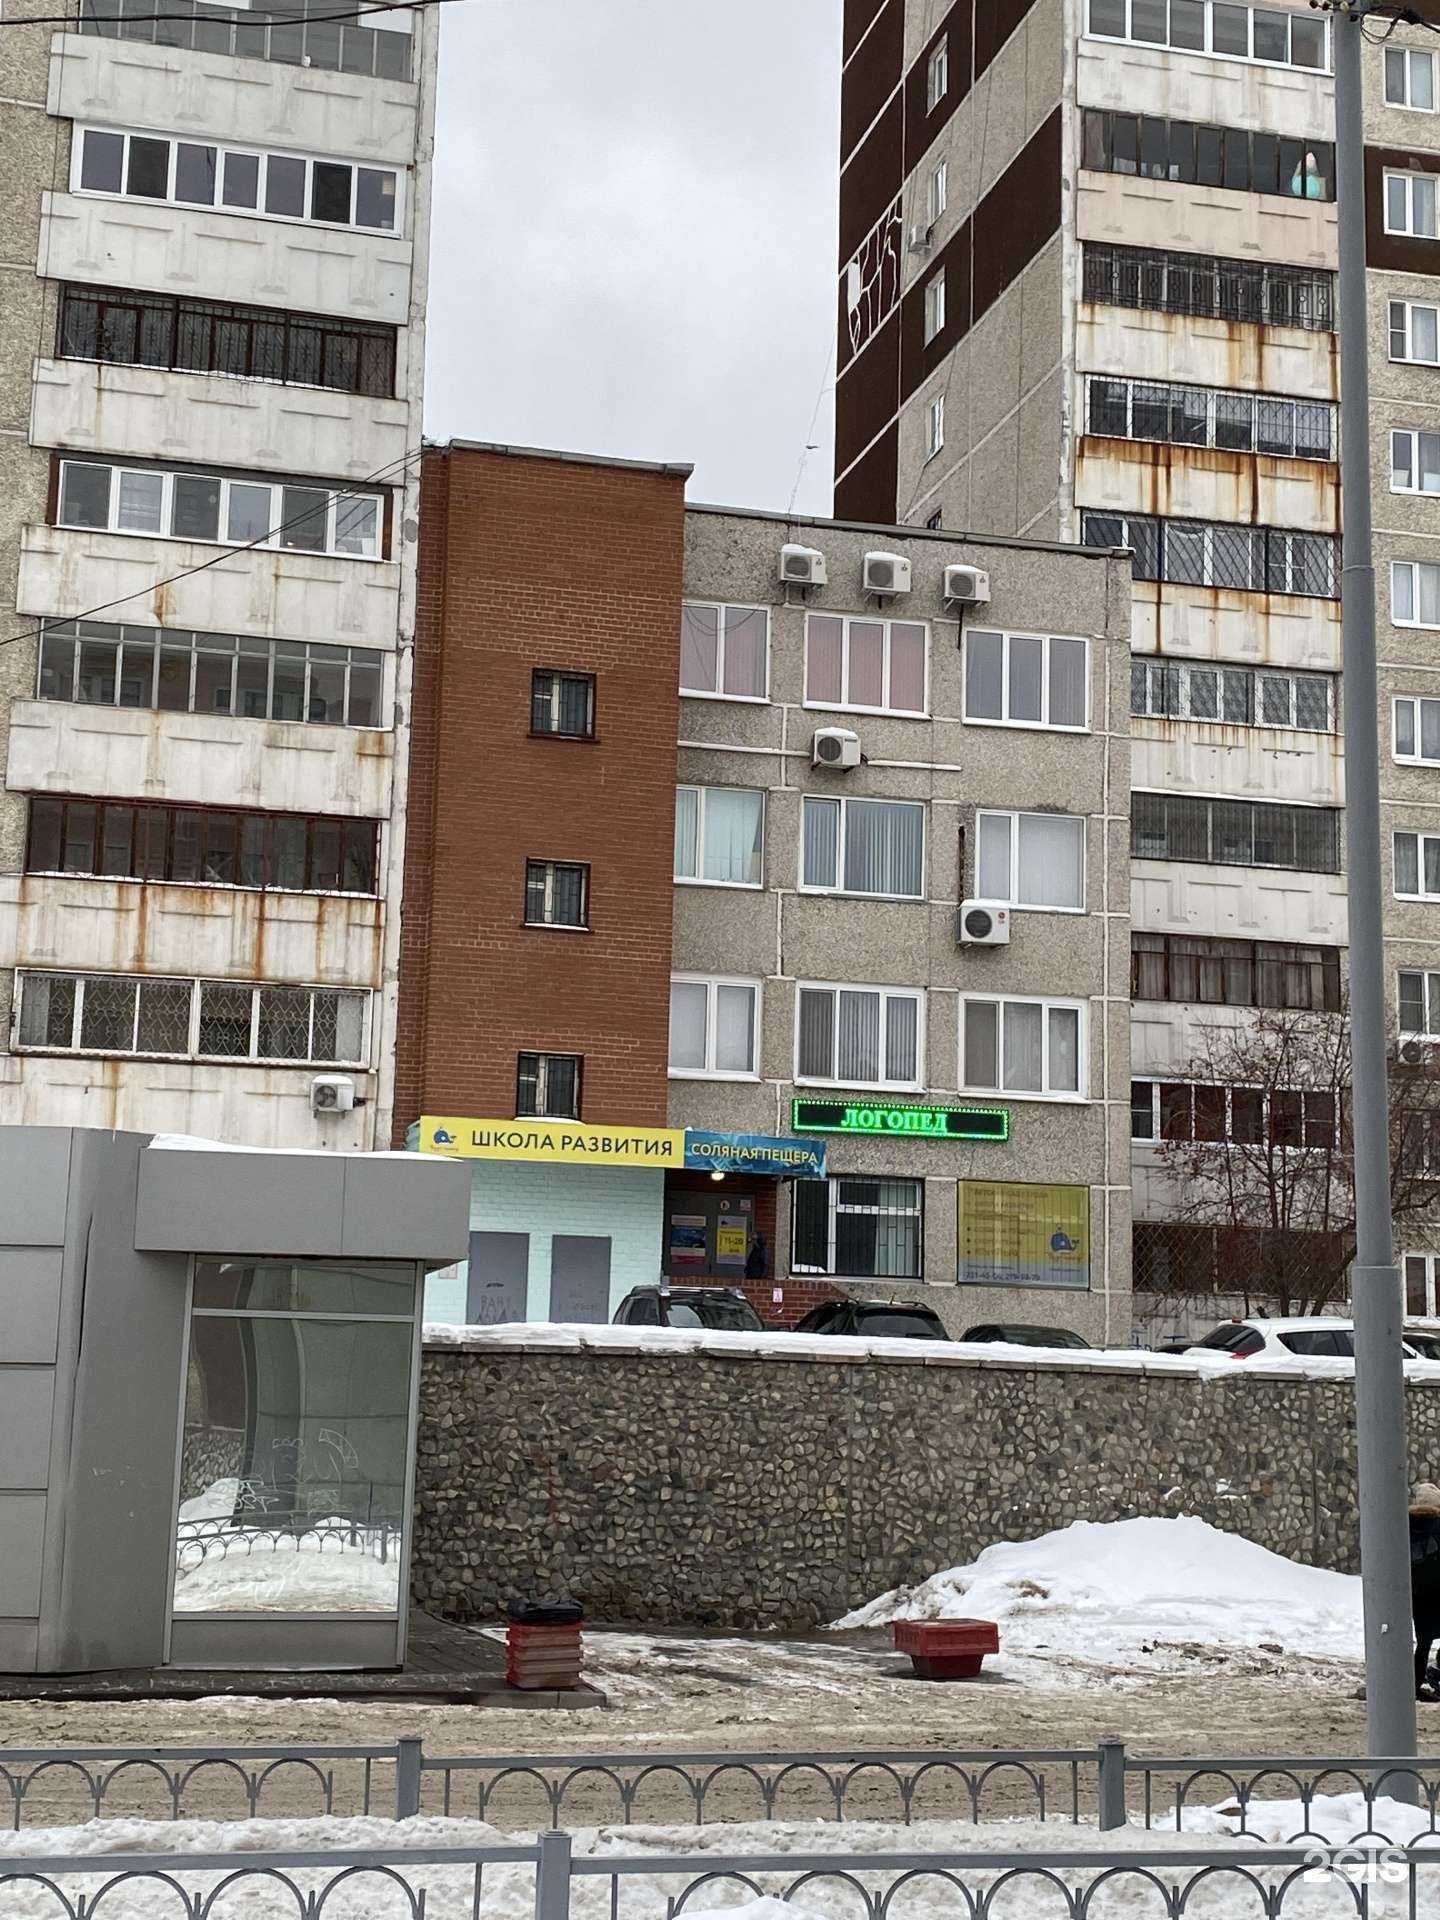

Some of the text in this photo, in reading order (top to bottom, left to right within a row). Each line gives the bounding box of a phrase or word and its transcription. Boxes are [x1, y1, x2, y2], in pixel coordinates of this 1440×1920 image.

[840, 1109, 948, 1134] ЛОГОПЕД
[471, 1129, 673, 1156] ШКОЛА РАЗВИТИЯ
[690, 1142, 819, 1165] СОЛЯНАЯ ПЕЩЕРА
